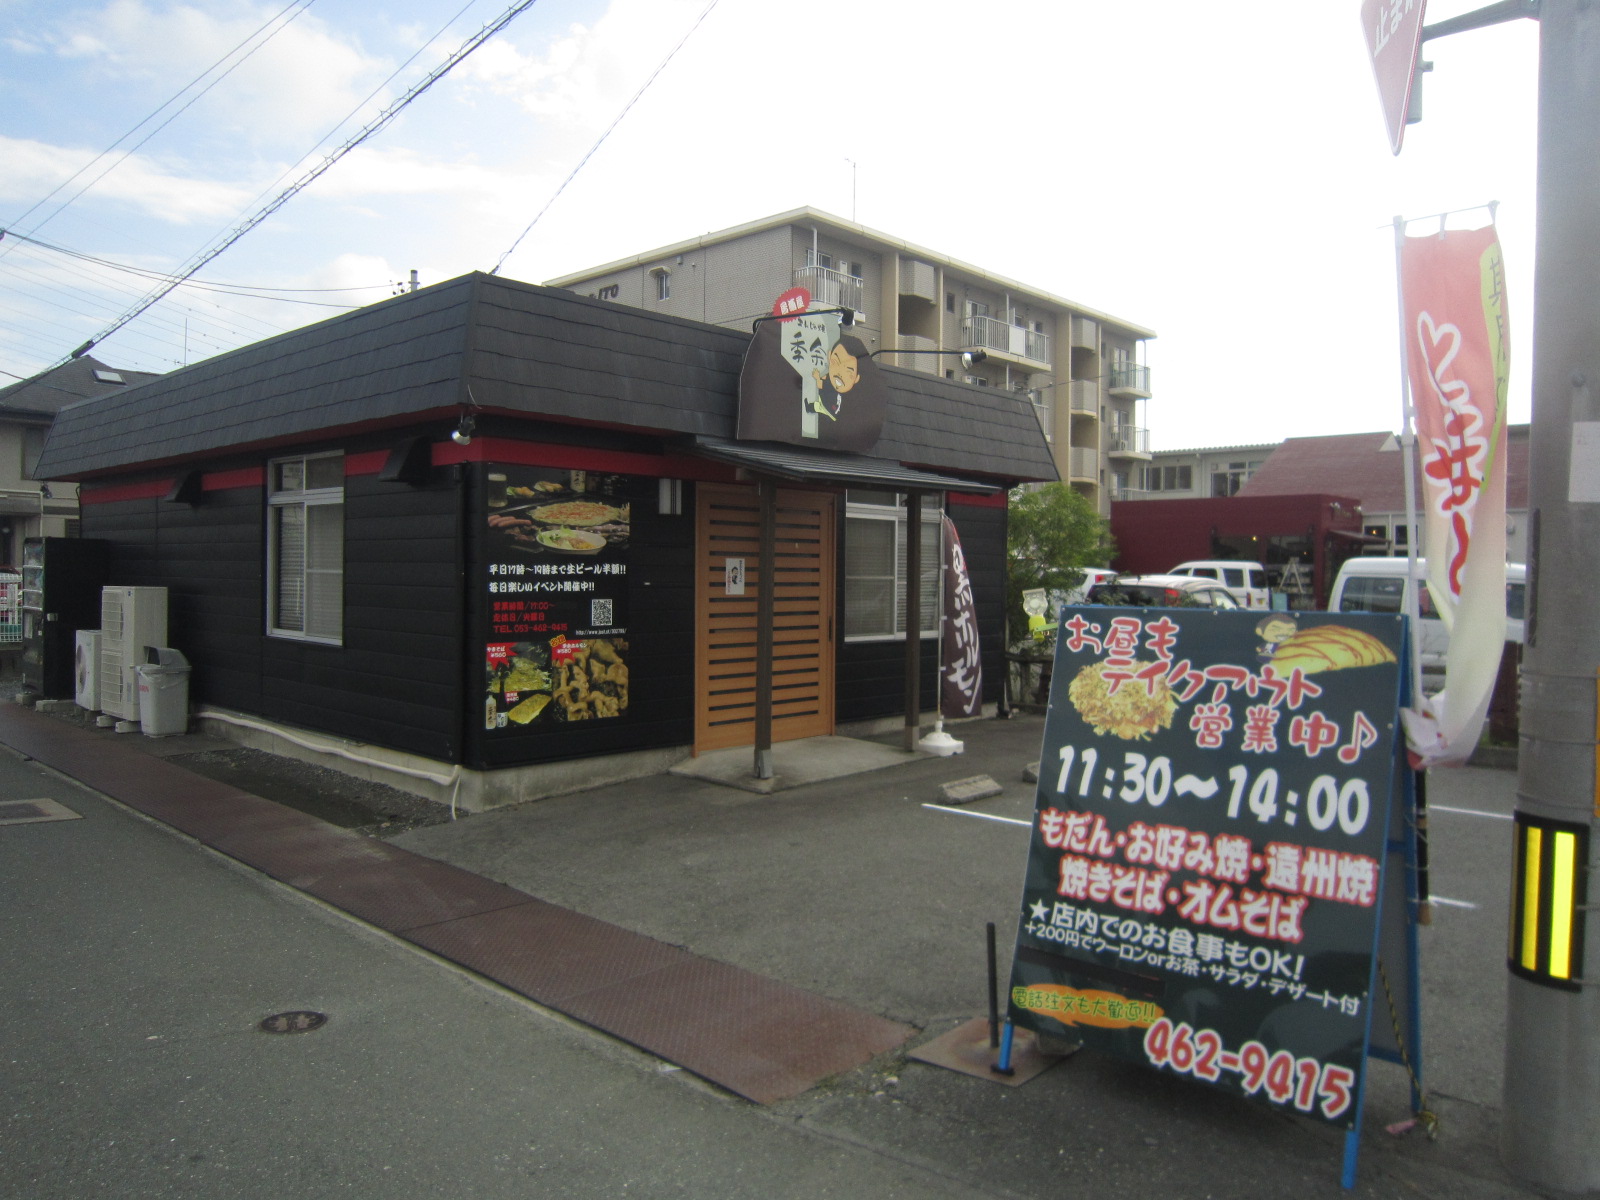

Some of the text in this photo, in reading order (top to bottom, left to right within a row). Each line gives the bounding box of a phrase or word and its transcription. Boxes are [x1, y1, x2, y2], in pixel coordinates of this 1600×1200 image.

[780, 295, 805, 315] 居酒屋
[489, 581, 595, 593] 毎日楽しいイベント開催中!!
[493, 625, 512, 633] TEL
[1065, 614, 1179, 660] お昼も
[1101, 657, 1322, 709] テイクアウト
[1038, 807, 1381, 906] もだん・お好み焼・遠州焼
[1058, 854, 1309, 943] 焼きそば・オムそば
[1144, 1016, 1354, 1119] 462-9415
